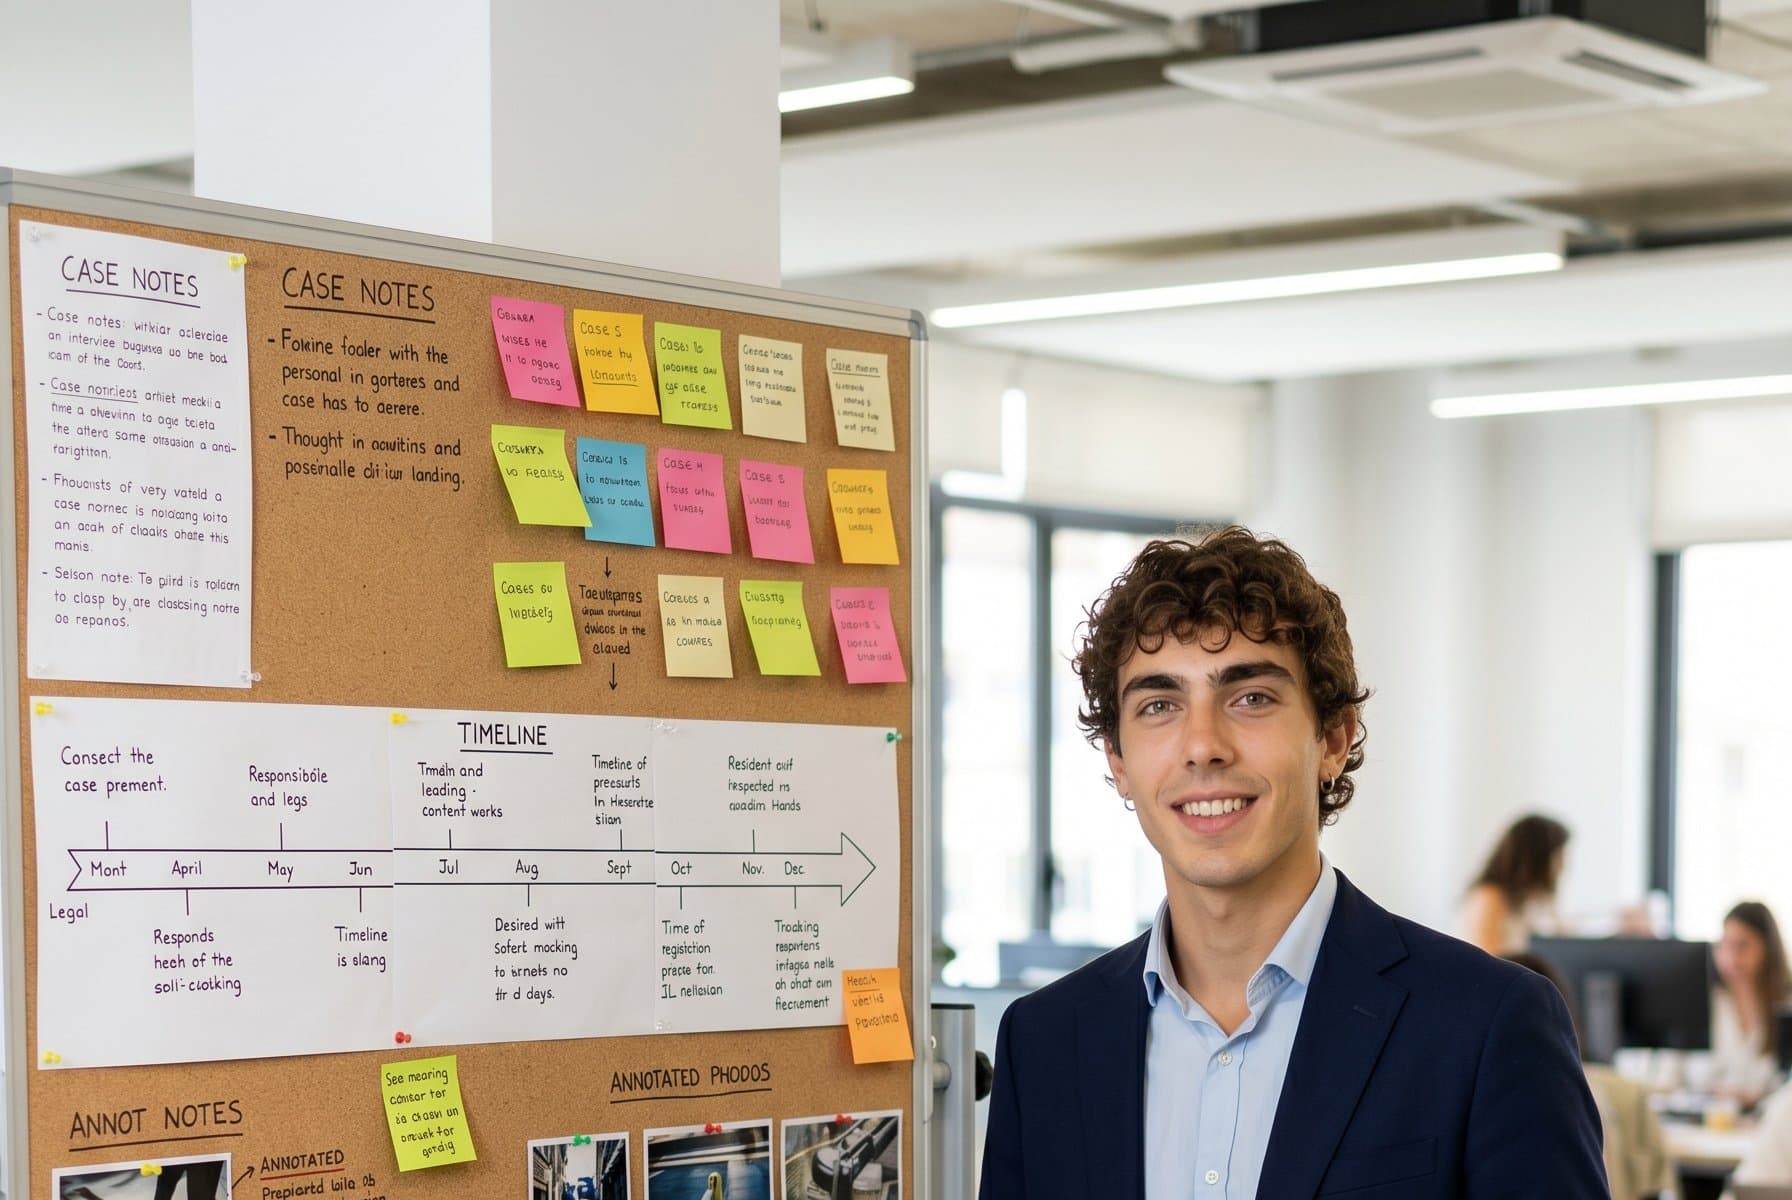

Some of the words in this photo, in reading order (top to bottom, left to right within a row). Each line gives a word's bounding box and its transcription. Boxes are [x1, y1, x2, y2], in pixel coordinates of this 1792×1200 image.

[62, 256, 119, 286] CASE
[133, 267, 199, 297] NOTES
[282, 267, 344, 300] CASE
[361, 278, 435, 312] NOTES
[48, 307, 78, 323] Case
[48, 331, 61, 340] an
[78, 353, 88, 364] of
[94, 355, 110, 367] the
[390, 344, 418, 362] with
[426, 346, 448, 364] the
[51, 378, 80, 393] Case
[283, 365, 341, 385] personal
[351, 368, 363, 384] in
[434, 375, 459, 391] and
[282, 394, 314, 408] case
[323, 393, 347, 411] has
[355, 396, 368, 412] to
[52, 422, 70, 434] the
[282, 426, 344, 455] Thought
[353, 433, 364, 449] in
[435, 439, 461, 455] and
[120, 481, 132, 492] of
[54, 499, 80, 510] case
[136, 506, 143, 517] is
[55, 522, 69, 530] an
[112, 524, 123, 534] of
[190, 576, 198, 588] is
[55, 590, 66, 602] to
[457, 722, 547, 745] TIMELINE
[61, 746, 121, 765] Consect
[130, 747, 154, 764] the
[637, 755, 647, 769] of
[729, 756, 771, 771] Resident
[460, 763, 483, 777] and
[65, 780, 97, 792] case
[107, 775, 166, 798] prement.
[422, 783, 466, 802] leading
[251, 792, 275, 806] and
[283, 792, 307, 812] legs
[422, 804, 466, 817] content
[91, 860, 127, 876] Mont
[172, 860, 202, 878] April
[268, 861, 294, 882] May
[350, 861, 372, 876] Jun
[439, 859, 459, 874] Jul
[515, 859, 539, 880] Aug
[607, 860, 632, 879] Sept
[671, 861, 692, 875] Oct
[742, 862, 764, 875] Nov.
[50, 903, 88, 924] Legal
[495, 917, 538, 932] Desired
[662, 920, 689, 935] Time
[694, 920, 705, 934] of
[154, 928, 214, 949] Responds
[334, 926, 388, 942] Timeline
[192, 954, 205, 967] of
[212, 952, 233, 967] the
[337, 953, 347, 967] is
[495, 965, 505, 977] to
[554, 967, 568, 976] no
[386, 1072, 404, 1086] See
[611, 1068, 699, 1093] ANNOTATED
[70, 1108, 146, 1140] ANNOT
[164, 1100, 243, 1129] NOTES
[261, 1150, 344, 1174] ANNOTATED
